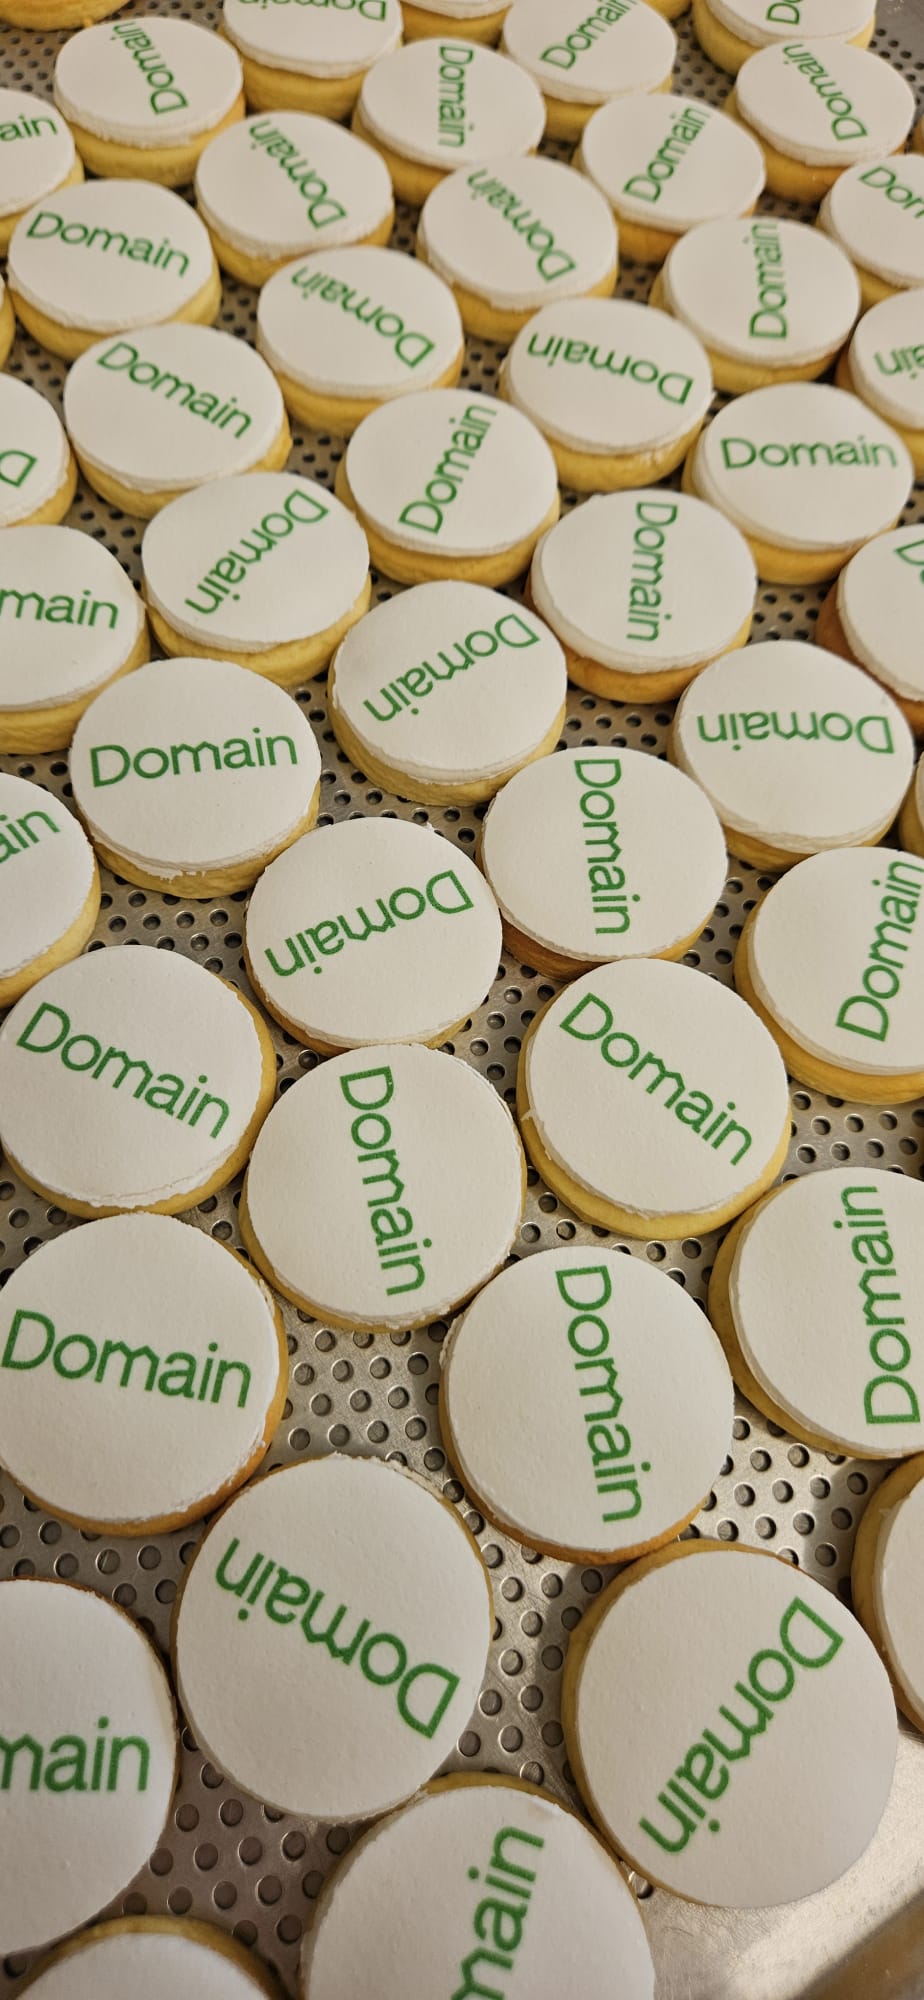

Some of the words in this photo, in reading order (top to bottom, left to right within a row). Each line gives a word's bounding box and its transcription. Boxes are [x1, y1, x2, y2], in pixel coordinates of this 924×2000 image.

[111, 22, 190, 116] Domain
[438, 45, 476, 147] Domain
[783, 44, 869, 141] Domain
[248, 121, 348, 229] Domain
[624, 106, 712, 203] Domain
[25, 211, 191, 277] Domain
[466, 171, 577, 282] Domain
[746, 223, 789, 340] Domain
[291, 268, 437, 369] Domain
[527, 334, 696, 406] Domain
[96, 342, 253, 439] Domain
[398, 405, 496, 535] Domain
[720, 436, 897, 470] Domain
[184, 489, 331, 616] Domain
[626, 501, 680, 642] Domain
[361, 613, 541, 723] Domain
[89, 727, 299, 788] Domain
[696, 711, 896, 755] Domain
[573, 758, 641, 935] Domain
[265, 870, 475, 978] Domain
[835, 860, 924, 1043] Domain
[16, 1002, 232, 1140] Domain
[560, 993, 753, 1166] Domain
[339, 1065, 433, 1296] Domain
[0, 1308, 254, 1408] Domain
[833, 1185, 922, 1426] Domain
[555, 1265, 653, 1524] Domain
[214, 1538, 462, 1740] Domain
[640, 1596, 847, 1855] Domain
